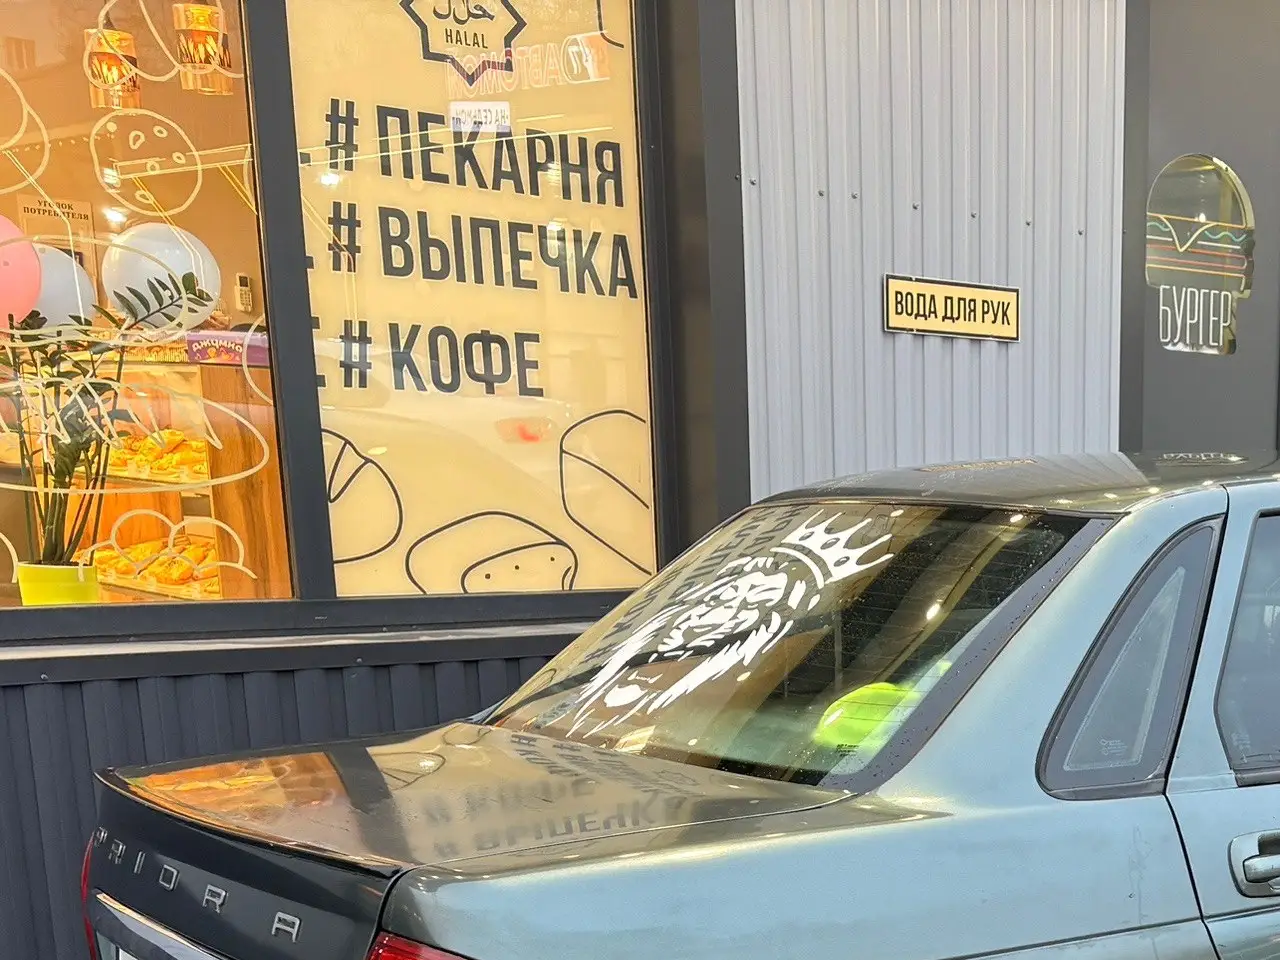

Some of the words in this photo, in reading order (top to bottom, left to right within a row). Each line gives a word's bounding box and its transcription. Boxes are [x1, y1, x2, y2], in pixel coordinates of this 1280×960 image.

[445, 28, 488, 49] HALAL
[376, 105, 624, 207] ПЕКАРНЯ
[378, 206, 638, 299] ВЫПЕЧКА
[895, 290, 938, 320] ВОДА
[942, 296, 977, 323] ДЛЯ
[981, 299, 1010, 325] РУК
[1160, 285, 1232, 346] БУРГЕР
[388, 321, 544, 398] КОФЕ
[94, 826, 301, 943] PRIORA
